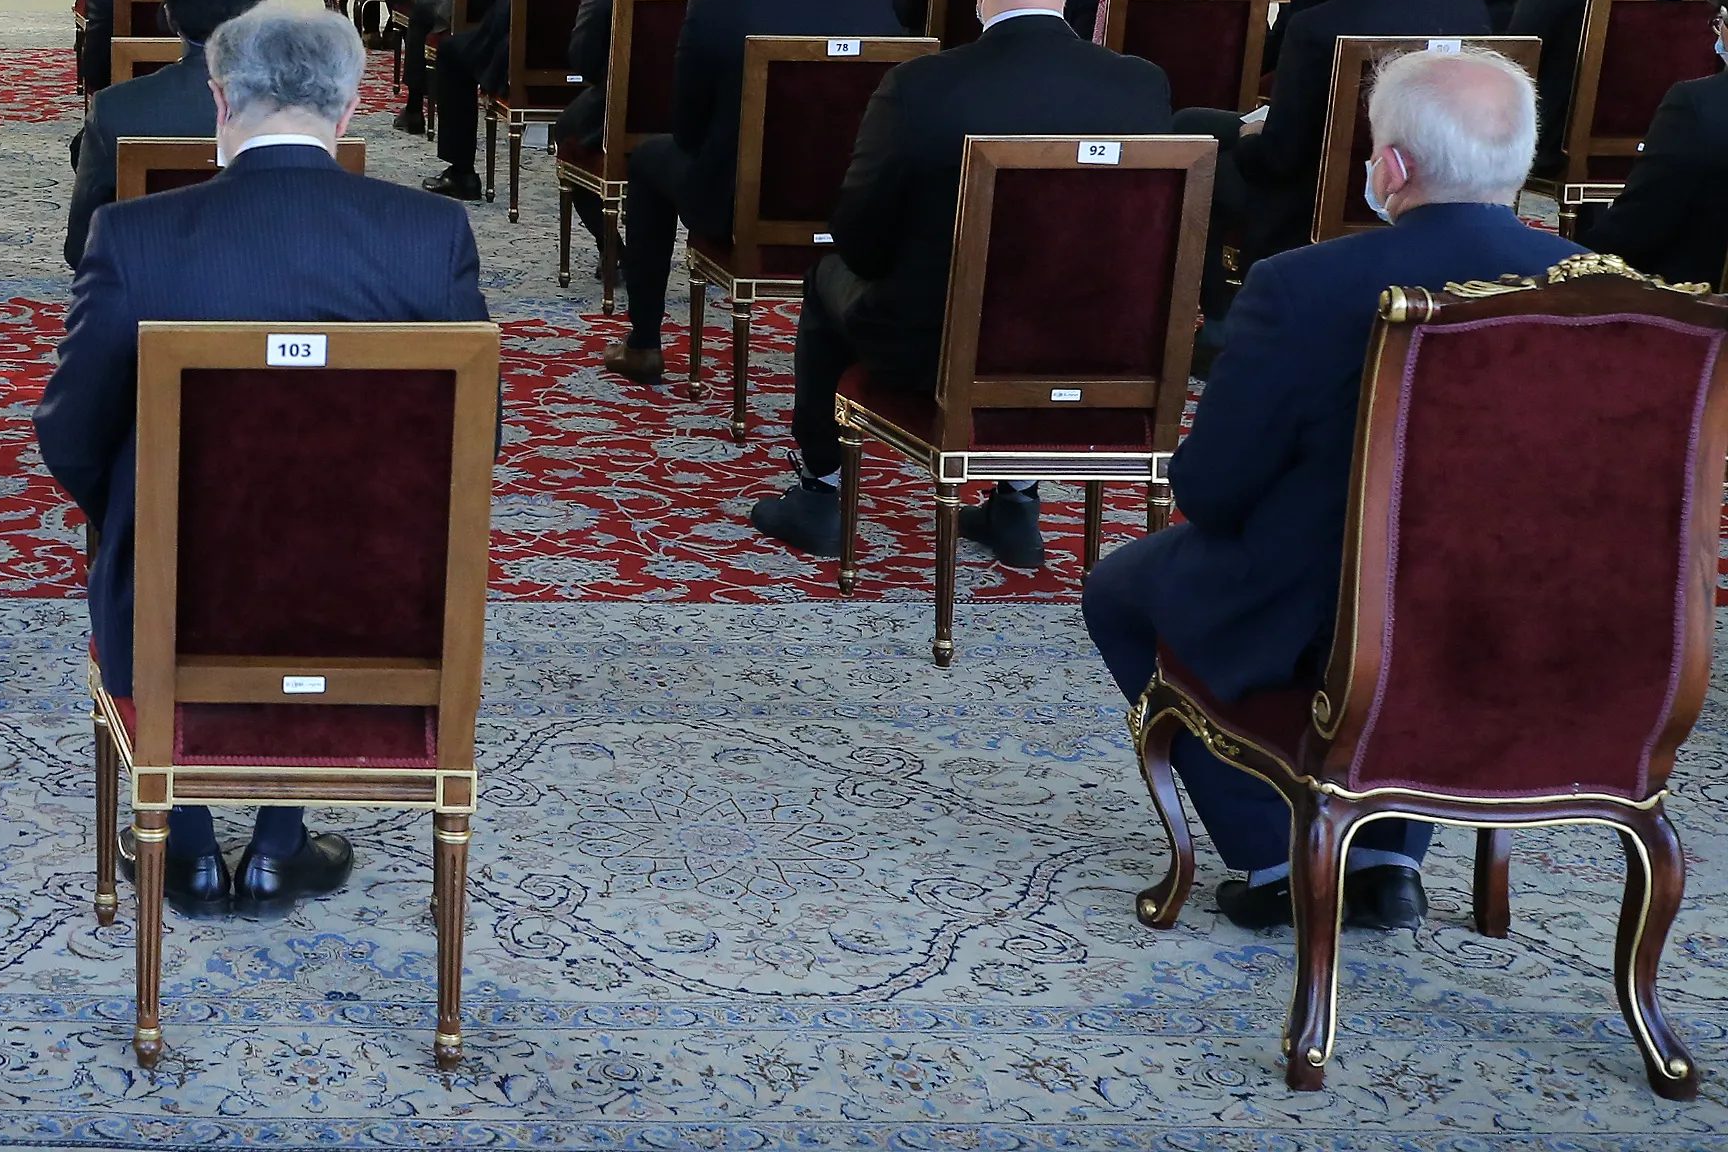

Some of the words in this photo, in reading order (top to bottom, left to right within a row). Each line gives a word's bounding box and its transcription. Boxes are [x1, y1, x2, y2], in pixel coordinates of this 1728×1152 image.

[836, 43, 849, 52] 78
[1089, 145, 1106, 156] 92
[279, 343, 311, 358] 103
